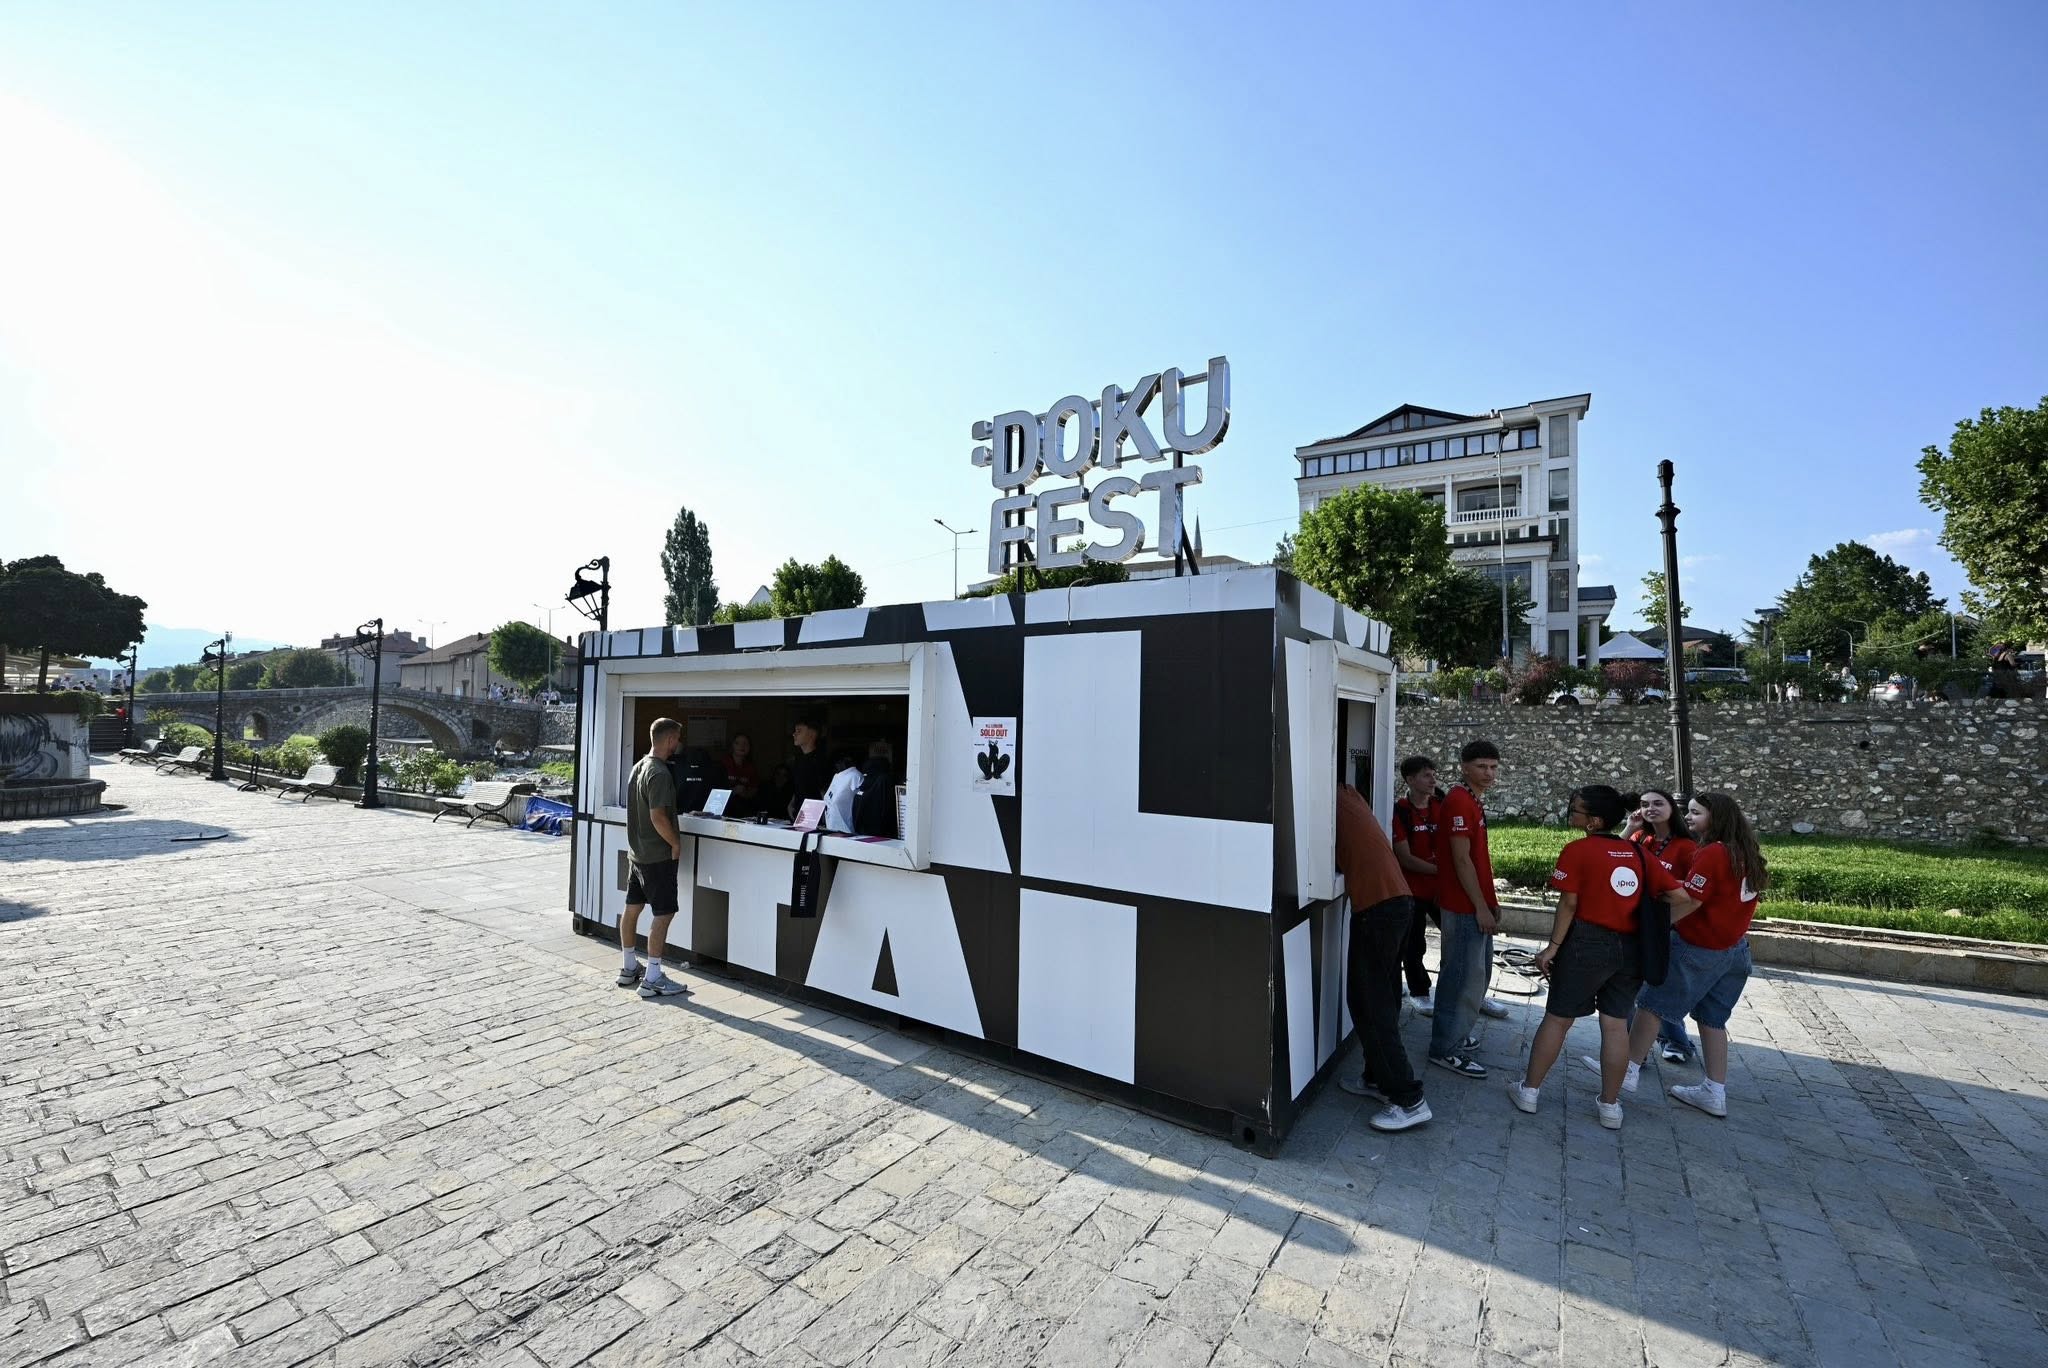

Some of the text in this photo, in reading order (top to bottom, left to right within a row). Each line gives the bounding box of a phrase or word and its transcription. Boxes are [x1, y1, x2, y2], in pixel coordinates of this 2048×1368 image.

[988, 465, 1202, 574] FEST
[980, 728, 1008, 737] SOLD OUT
